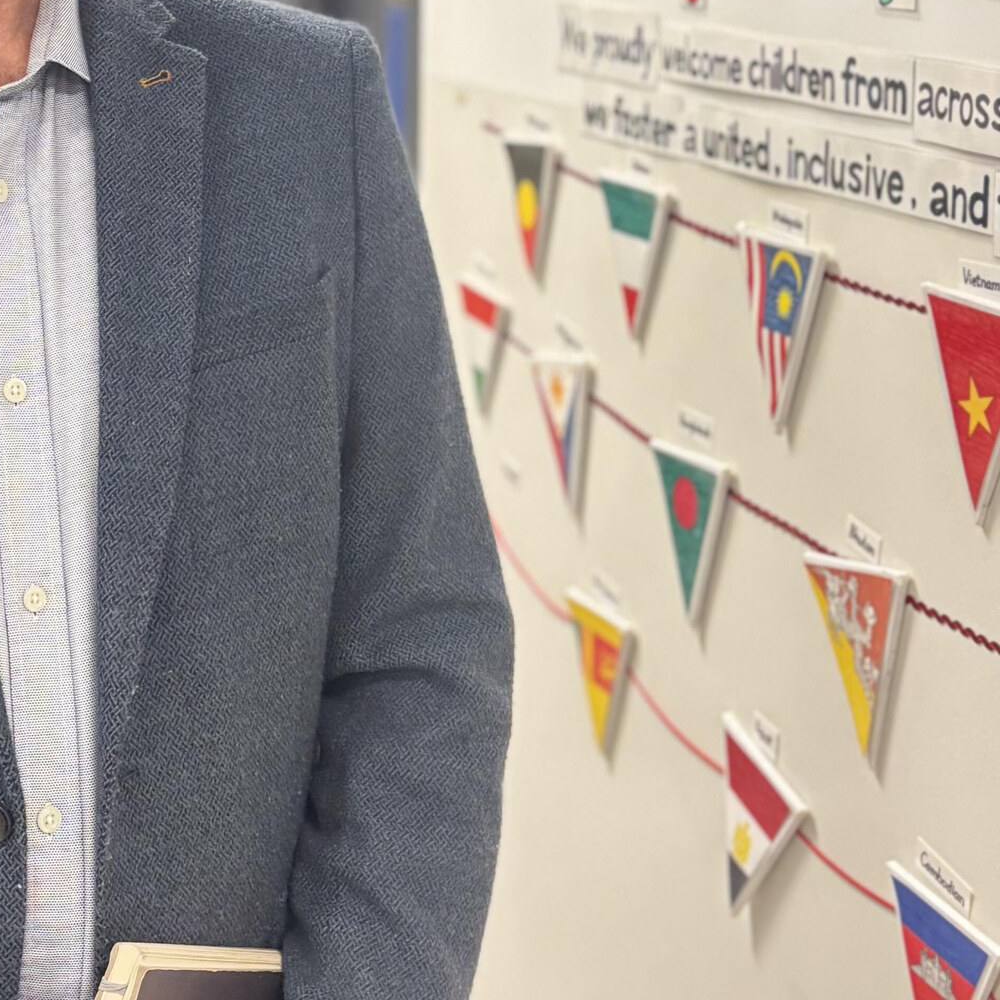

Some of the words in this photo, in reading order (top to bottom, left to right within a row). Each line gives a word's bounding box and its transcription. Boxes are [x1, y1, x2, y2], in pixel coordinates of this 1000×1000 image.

[592, 24, 653, 81] proudly
[661, 36, 743, 84] welcome
[747, 44, 836, 103] children
[841, 56, 908, 116] from
[613, 96, 676, 149] foster
[683, 123, 698, 153] a
[929, 173, 990, 229] and
